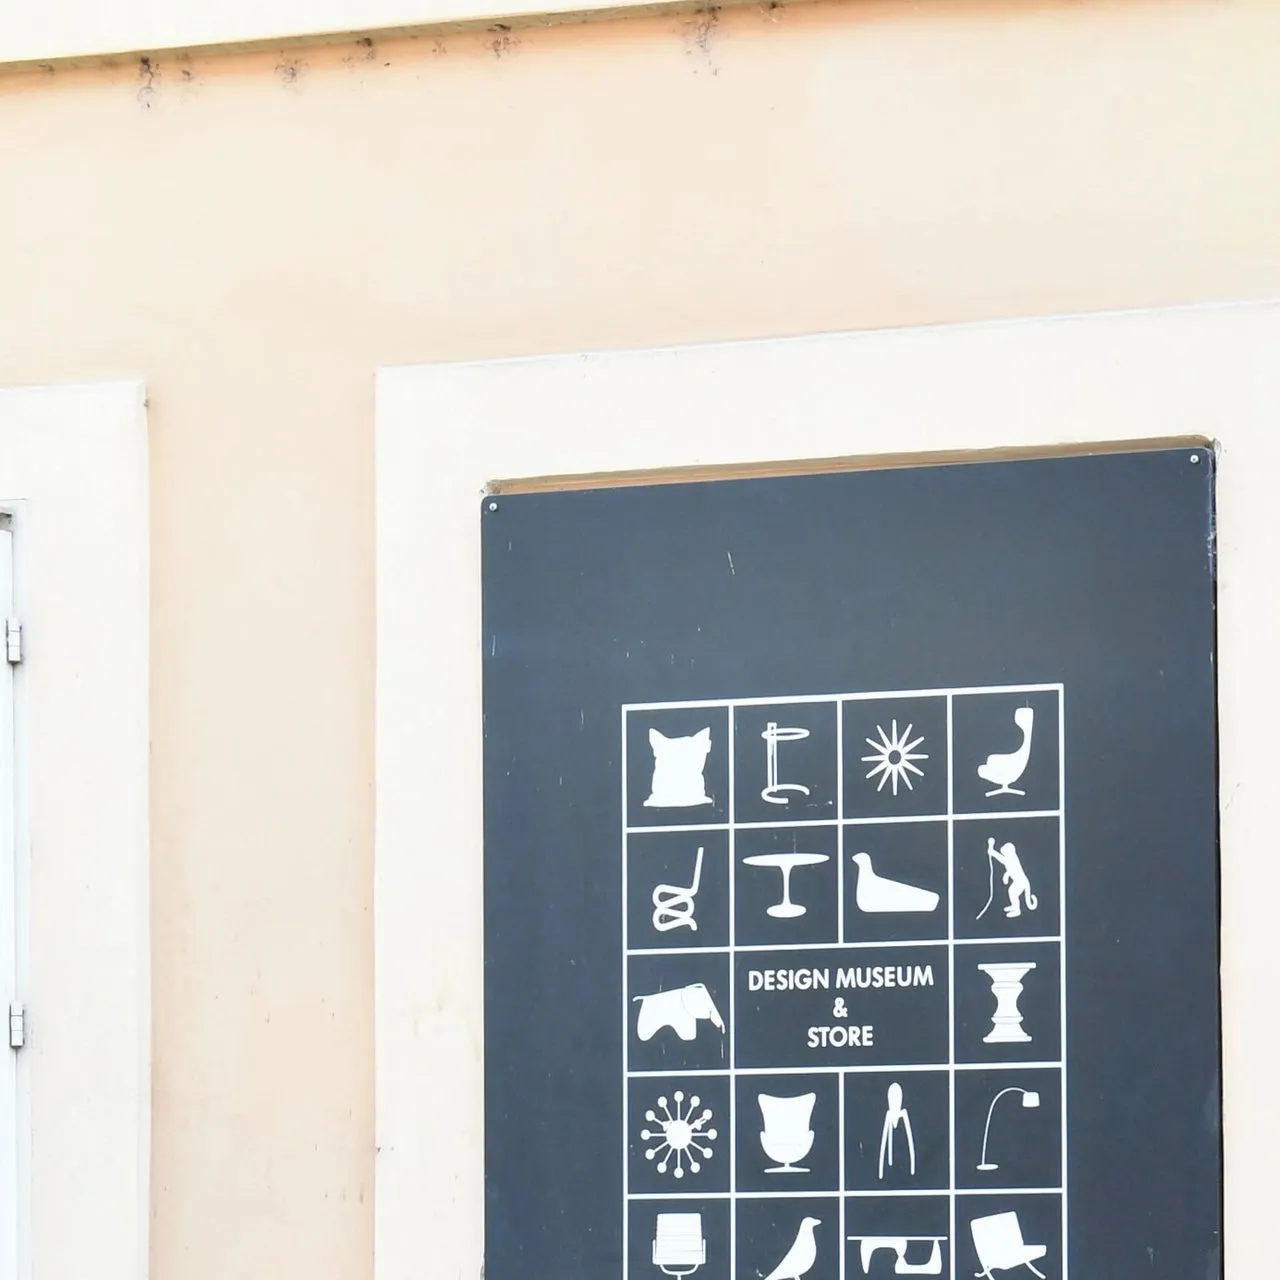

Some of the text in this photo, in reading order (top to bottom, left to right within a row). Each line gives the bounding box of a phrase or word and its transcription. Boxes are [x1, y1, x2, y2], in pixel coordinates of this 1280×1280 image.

[748, 965, 934, 991] DESIGN MUSEUM
[832, 997, 848, 1018] &
[807, 1025, 874, 1048] STORE
